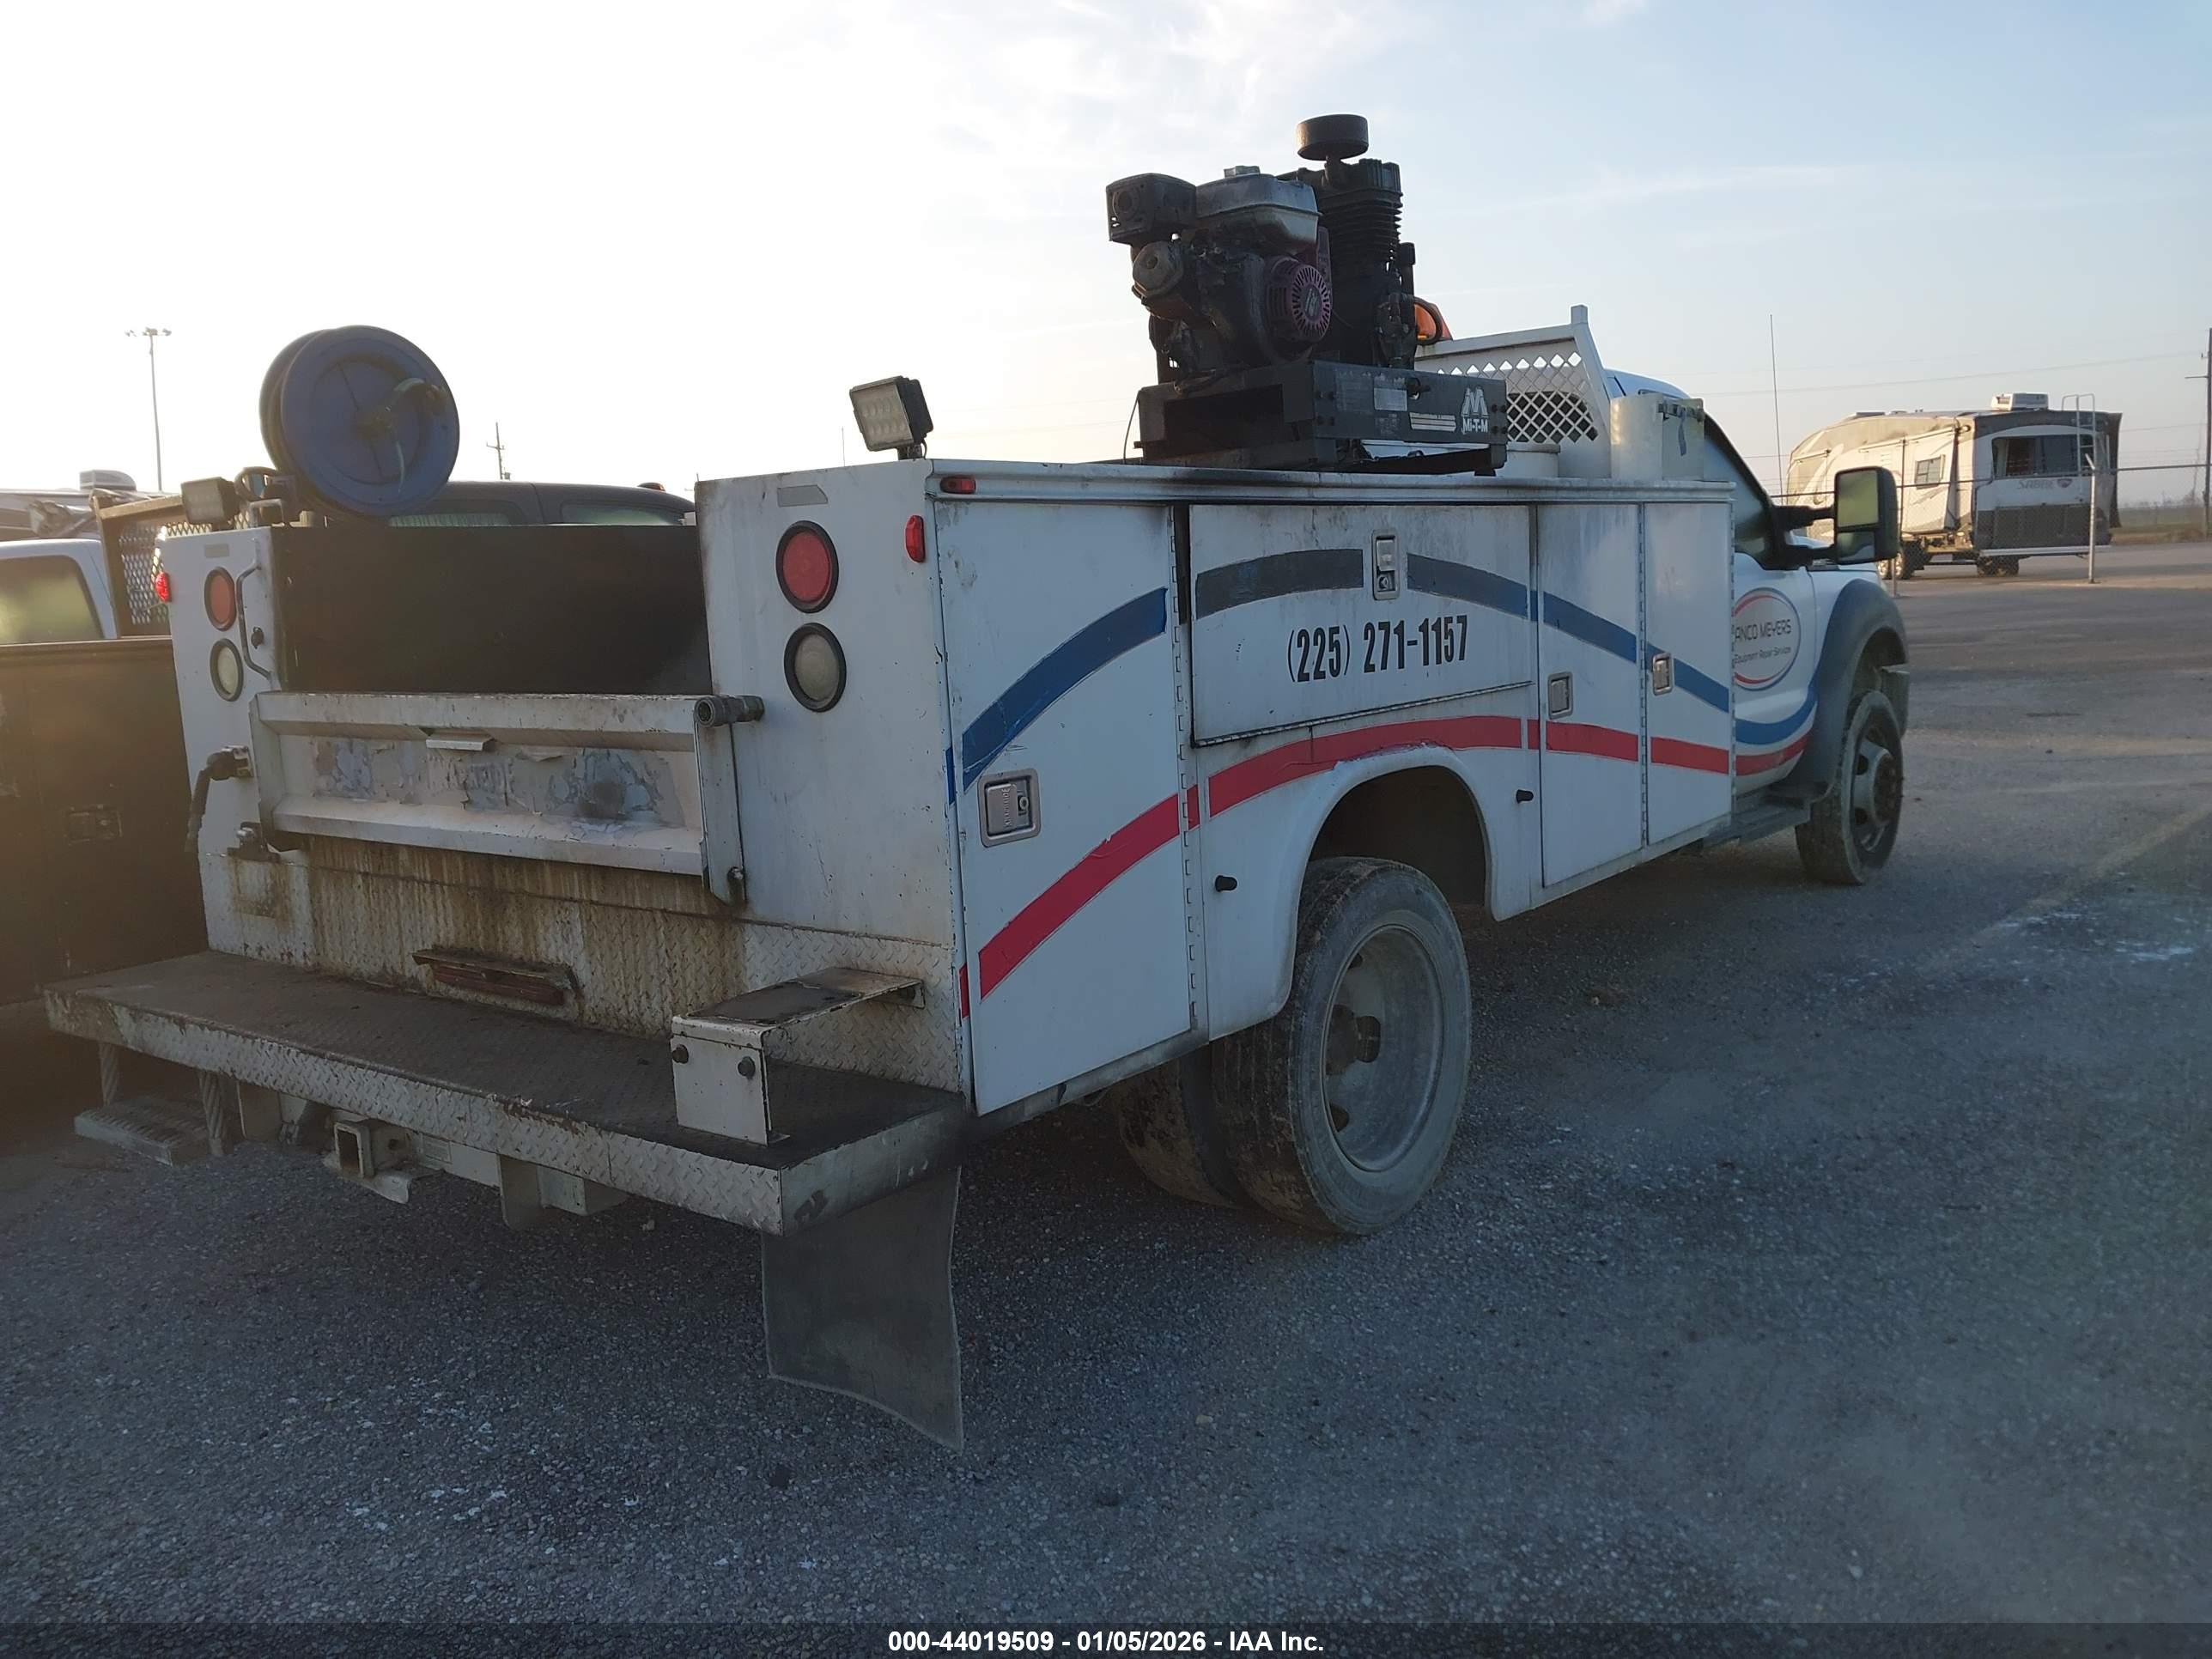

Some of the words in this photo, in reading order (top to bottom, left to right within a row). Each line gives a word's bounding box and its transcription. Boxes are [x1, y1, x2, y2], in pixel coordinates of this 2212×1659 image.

[1288, 624, 1351, 683] (225)
[1363, 615, 1468, 673] 271-1157
[1734, 623, 1758, 642] ANCO
[1759, 618, 1791, 638] MEYERS
